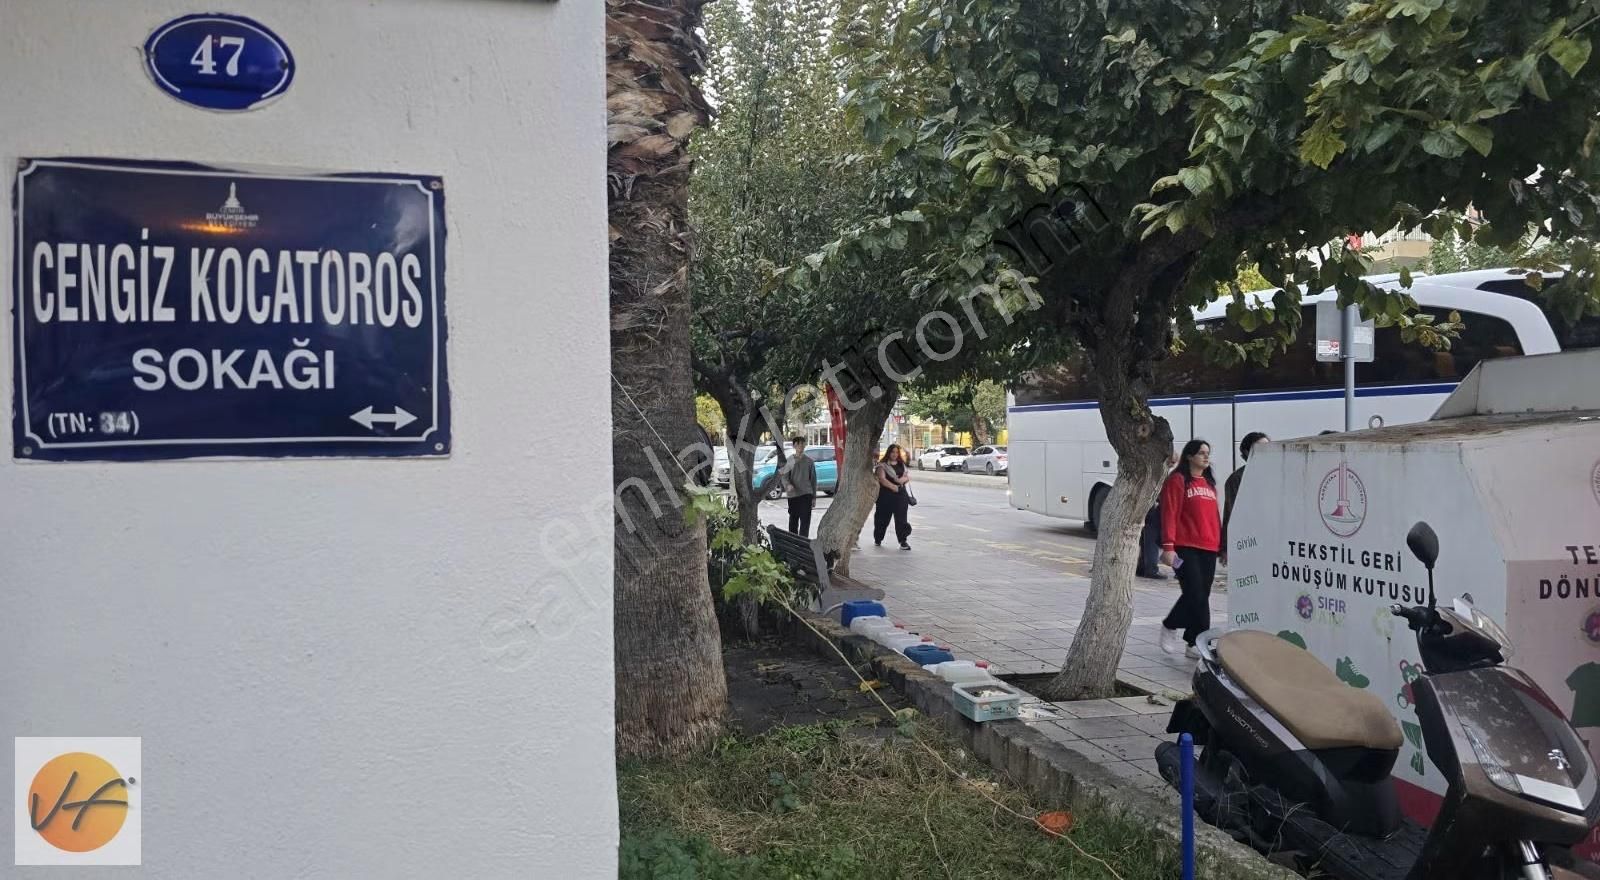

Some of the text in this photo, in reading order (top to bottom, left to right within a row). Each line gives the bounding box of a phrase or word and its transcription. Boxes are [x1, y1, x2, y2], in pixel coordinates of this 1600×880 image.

[190, 35, 245, 77] 47
[32, 228, 423, 328] CENGİZ KOCATOROS
[133, 338, 335, 390] SOKAĞI
[48, 412, 94, 438] (TN:
[1288, 540, 1402, 573] TEKSTİL GERİ
[1565, 545, 1600, 565] TE
[1272, 562, 1425, 605] DÖNÜŞÜM KUTUSU
[1235, 612, 1260, 627] ÇANTA
[1318, 596, 1346, 614] SIFIR
